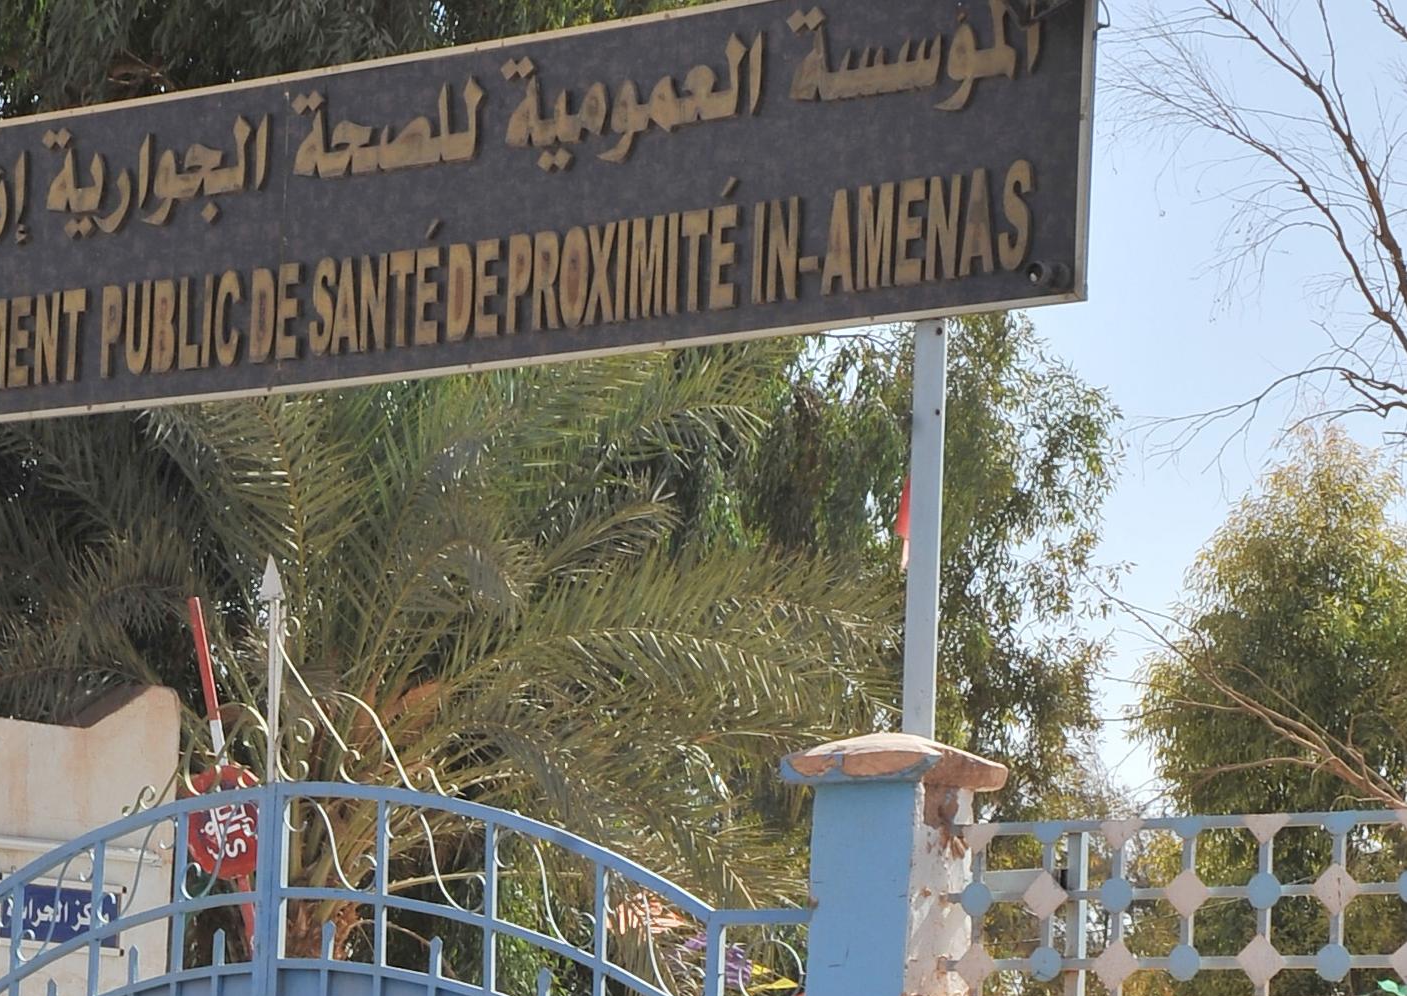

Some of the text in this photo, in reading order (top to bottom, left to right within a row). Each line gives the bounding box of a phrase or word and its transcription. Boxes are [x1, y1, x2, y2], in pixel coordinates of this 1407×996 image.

[291, 75, 485, 179] للصحة
[500, 31, 766, 173] العمومية
[45, 111, 274, 240] الجوارية
[100, 269, 244, 379] PUBLIC
[249, 262, 303, 364] DE
[308, 218, 440, 358] SANTÉ
[446, 239, 502, 343] DE
[506, 176, 740, 336] PROXIMITÉ
[752, 159, 1035, 304] IN-AMENAS
